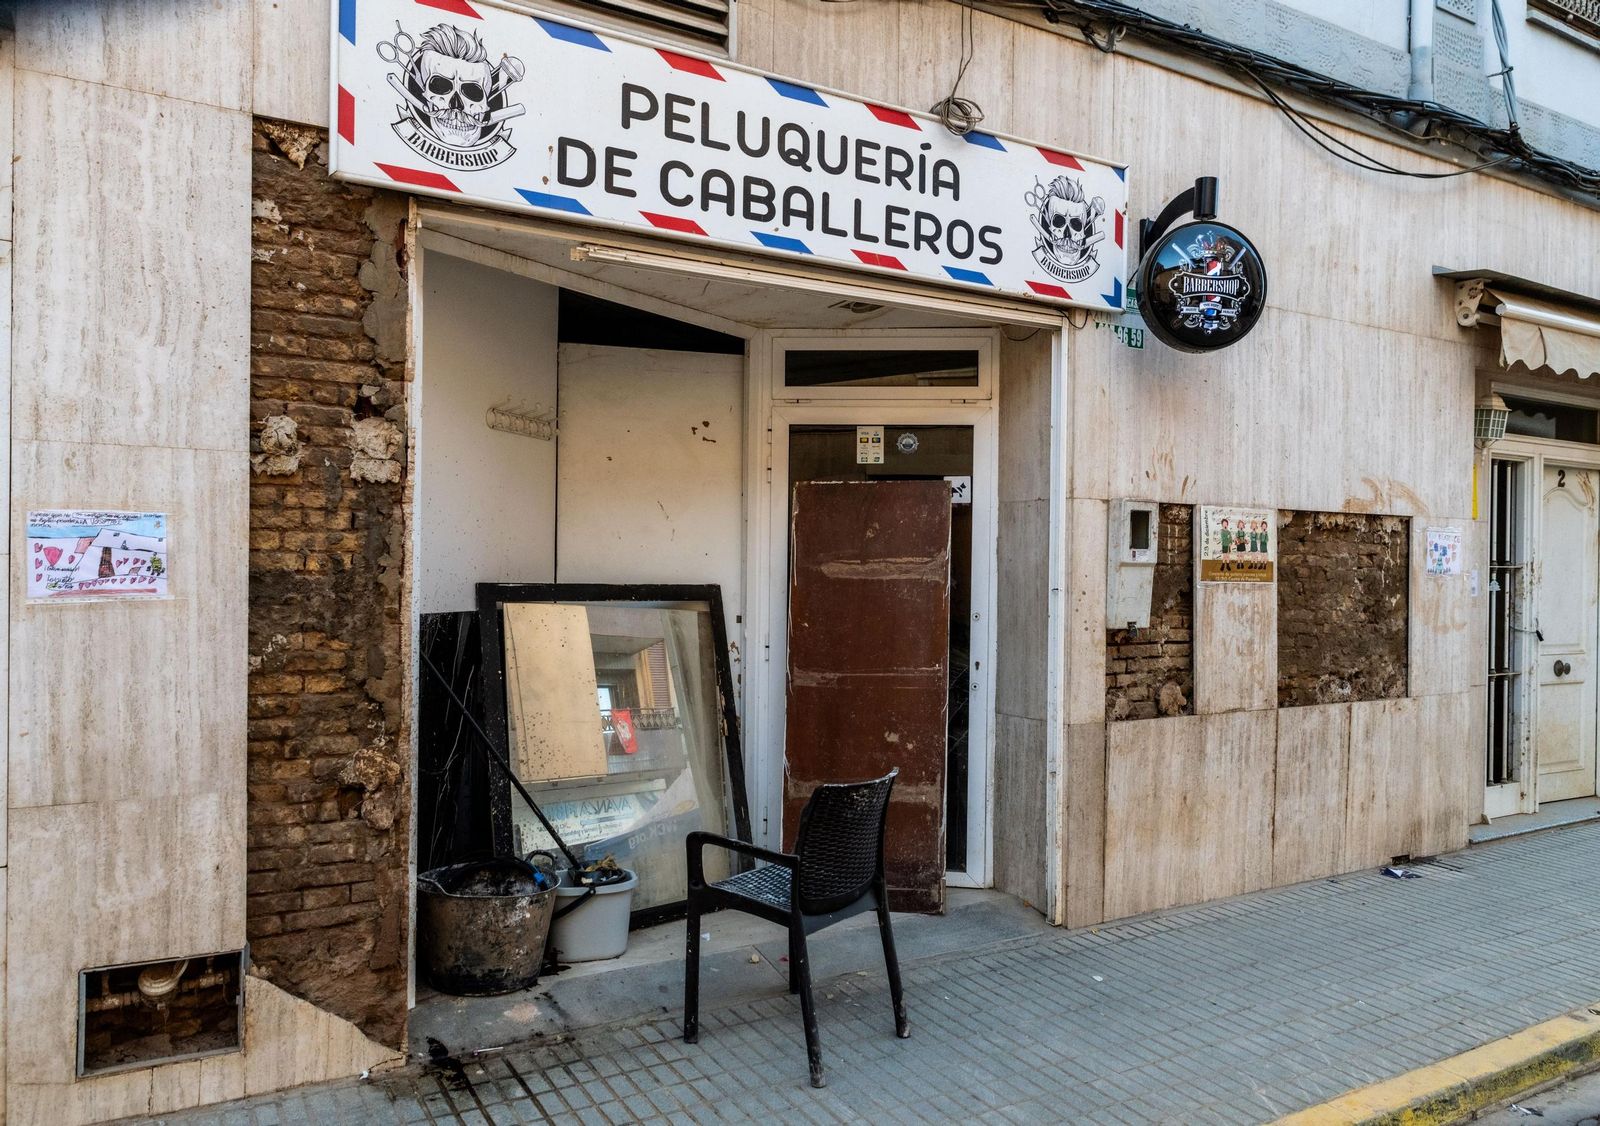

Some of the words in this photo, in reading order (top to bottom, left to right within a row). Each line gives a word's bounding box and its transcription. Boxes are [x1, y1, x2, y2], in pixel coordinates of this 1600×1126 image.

[407, 131, 498, 167] BARBERSHOP
[620, 82, 961, 202] PELUQUERÍA
[556, 136, 638, 198] DE
[659, 160, 1004, 266] CABALLEROS
[1040, 256, 1090, 280] BARBERSHOP
[1183, 276, 1240, 296] BARBERSHOP
[1131, 328, 1142, 347] 59
[1558, 469, 1566, 487] 2
